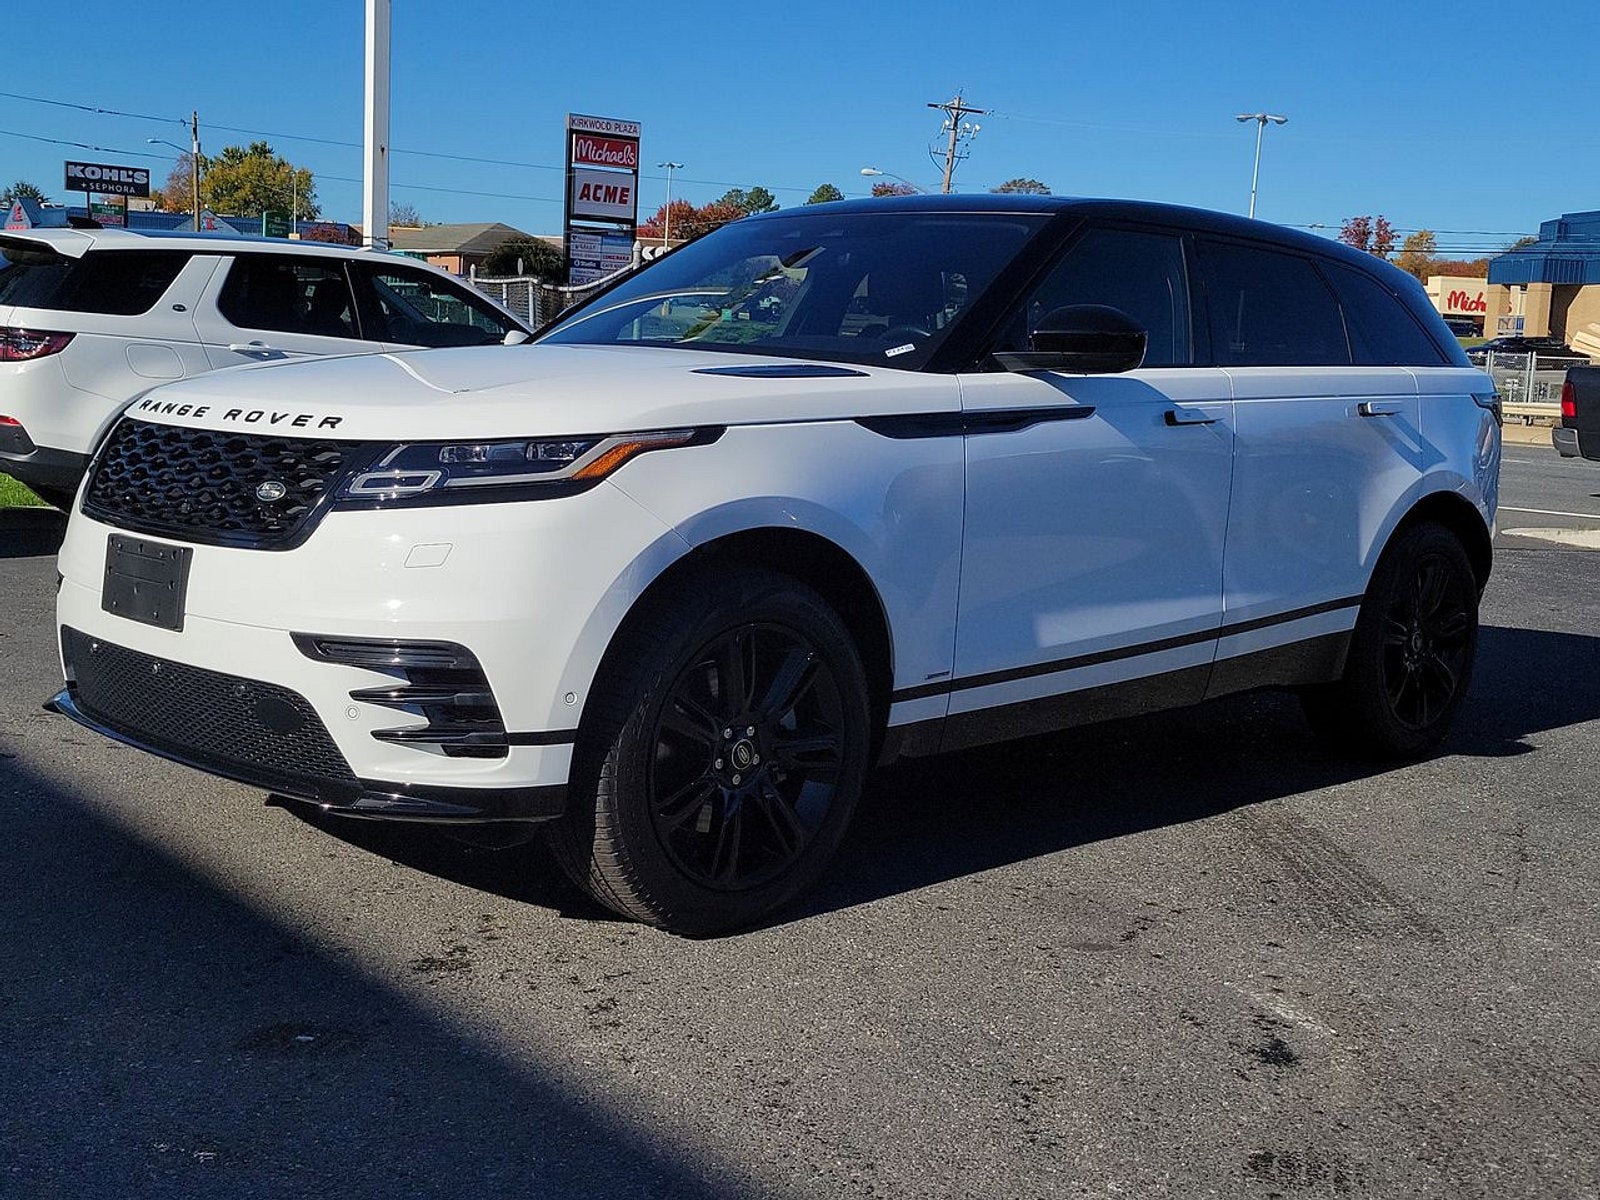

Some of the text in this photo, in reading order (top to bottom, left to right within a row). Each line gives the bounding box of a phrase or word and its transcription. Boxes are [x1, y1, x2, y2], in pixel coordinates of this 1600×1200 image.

[571, 117, 638, 134] KIRKWOOD PLAZA
[576, 139, 635, 165] Michaels
[67, 164, 148, 184] KOHL'S
[89, 182, 135, 194] SEPHORA
[578, 182, 630, 205] ACME
[1447, 290, 1512, 313] Mich
[139, 399, 343, 429] RANGE ROVER
